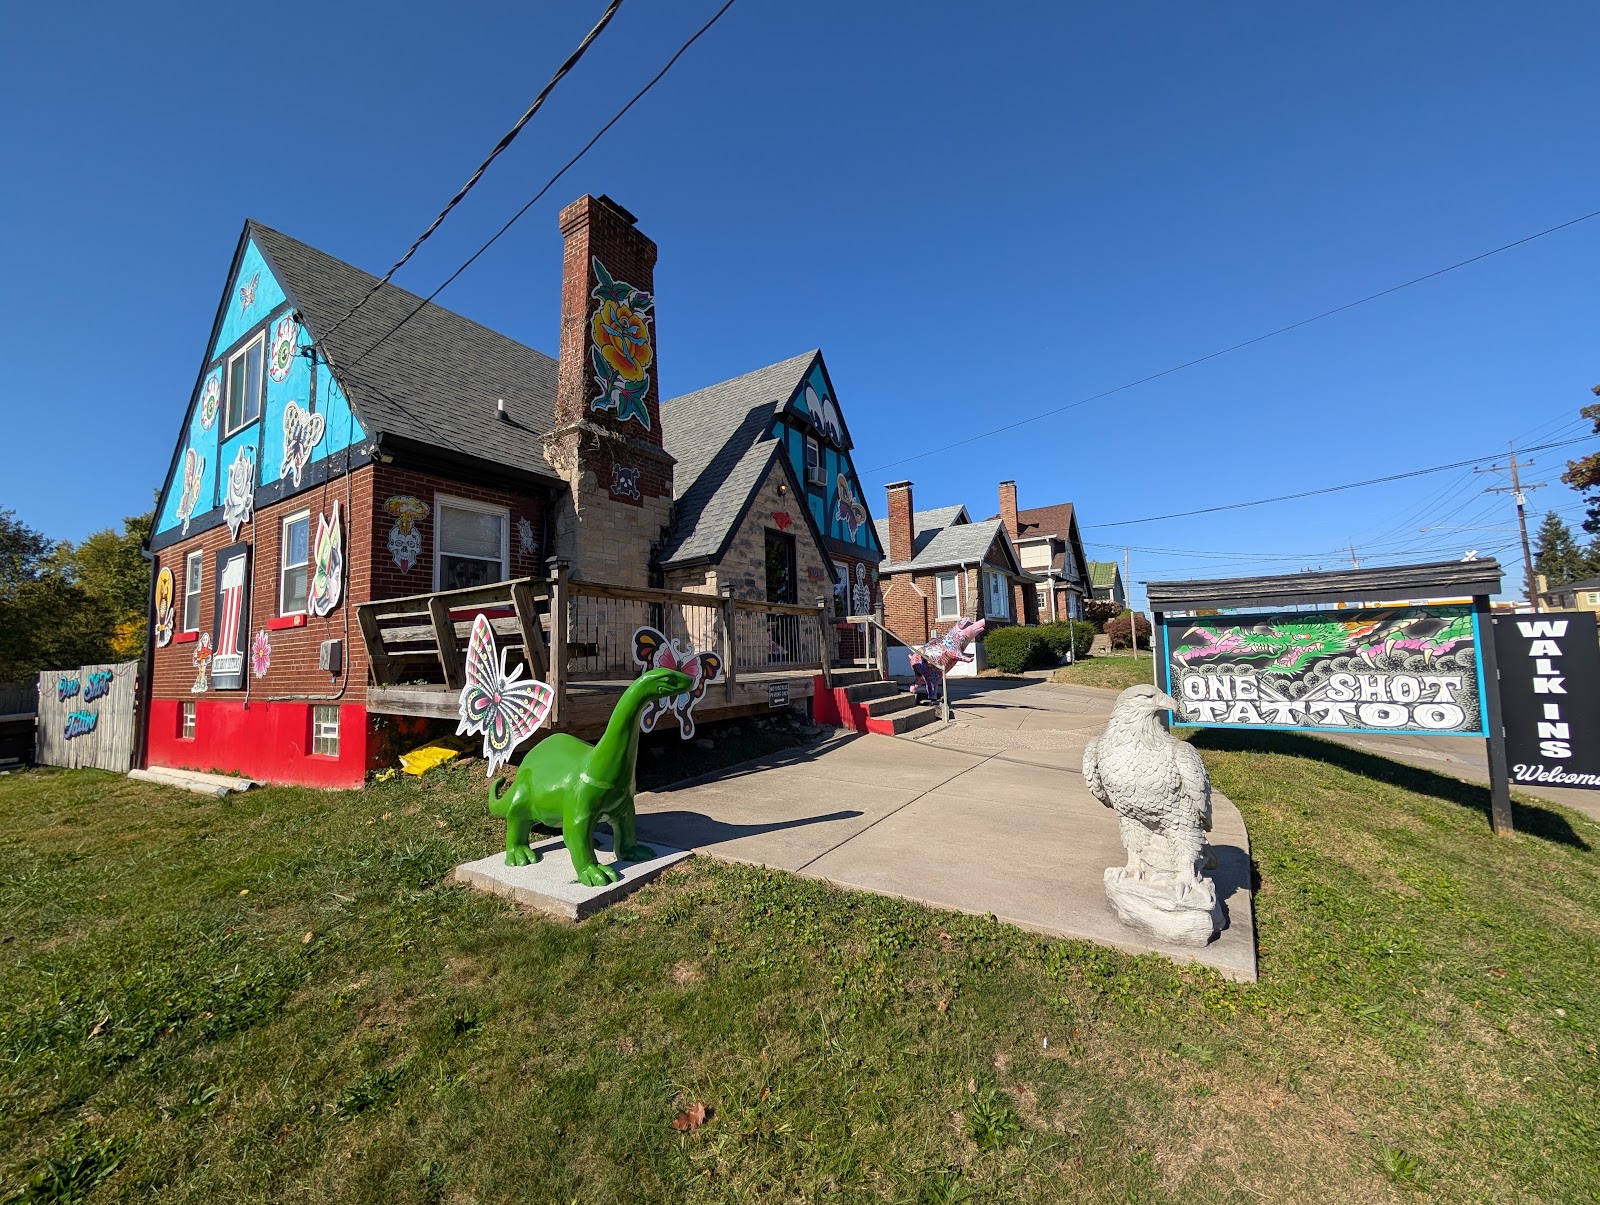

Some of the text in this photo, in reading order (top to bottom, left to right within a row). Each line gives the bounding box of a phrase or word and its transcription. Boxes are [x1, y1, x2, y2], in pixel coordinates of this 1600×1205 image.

[58, 669, 113, 703] One Shot
[1183, 673, 1463, 703] ONE SHOT
[1516, 620, 1573, 759] WALK INS
[64, 709, 99, 740] Tattoo
[1184, 700, 1466, 729] TATTOO
